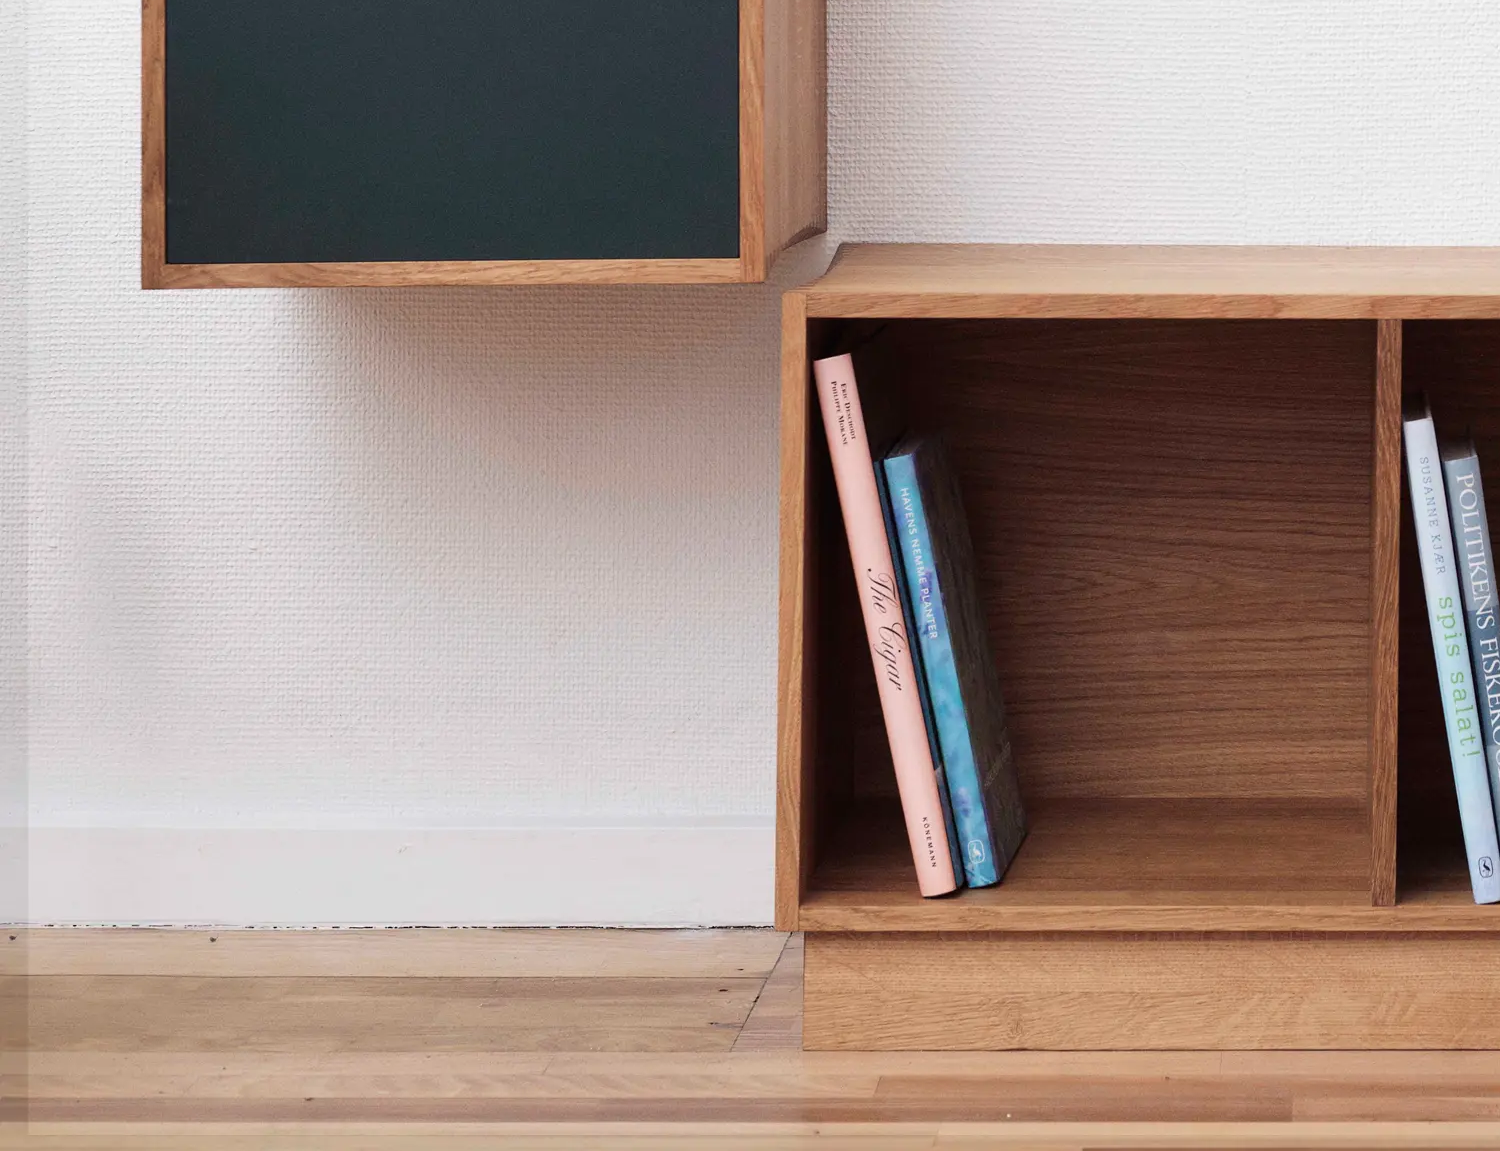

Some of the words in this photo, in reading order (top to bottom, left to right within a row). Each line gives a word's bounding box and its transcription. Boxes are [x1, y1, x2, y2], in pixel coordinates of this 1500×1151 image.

[900, 487, 918, 536] HAVENS
[911, 538, 928, 585] NEMME
[920, 588, 938, 639] PLANTER
[1419, 456, 1439, 528] SUSANNE
[1431, 534, 1446, 575] KJÆR
[1455, 472, 1496, 630] POLITIKENS
[867, 568, 900, 614] The
[873, 622, 908, 691] Cigar
[1436, 596, 1463, 657] spis
[1450, 671, 1481, 757] salat!
